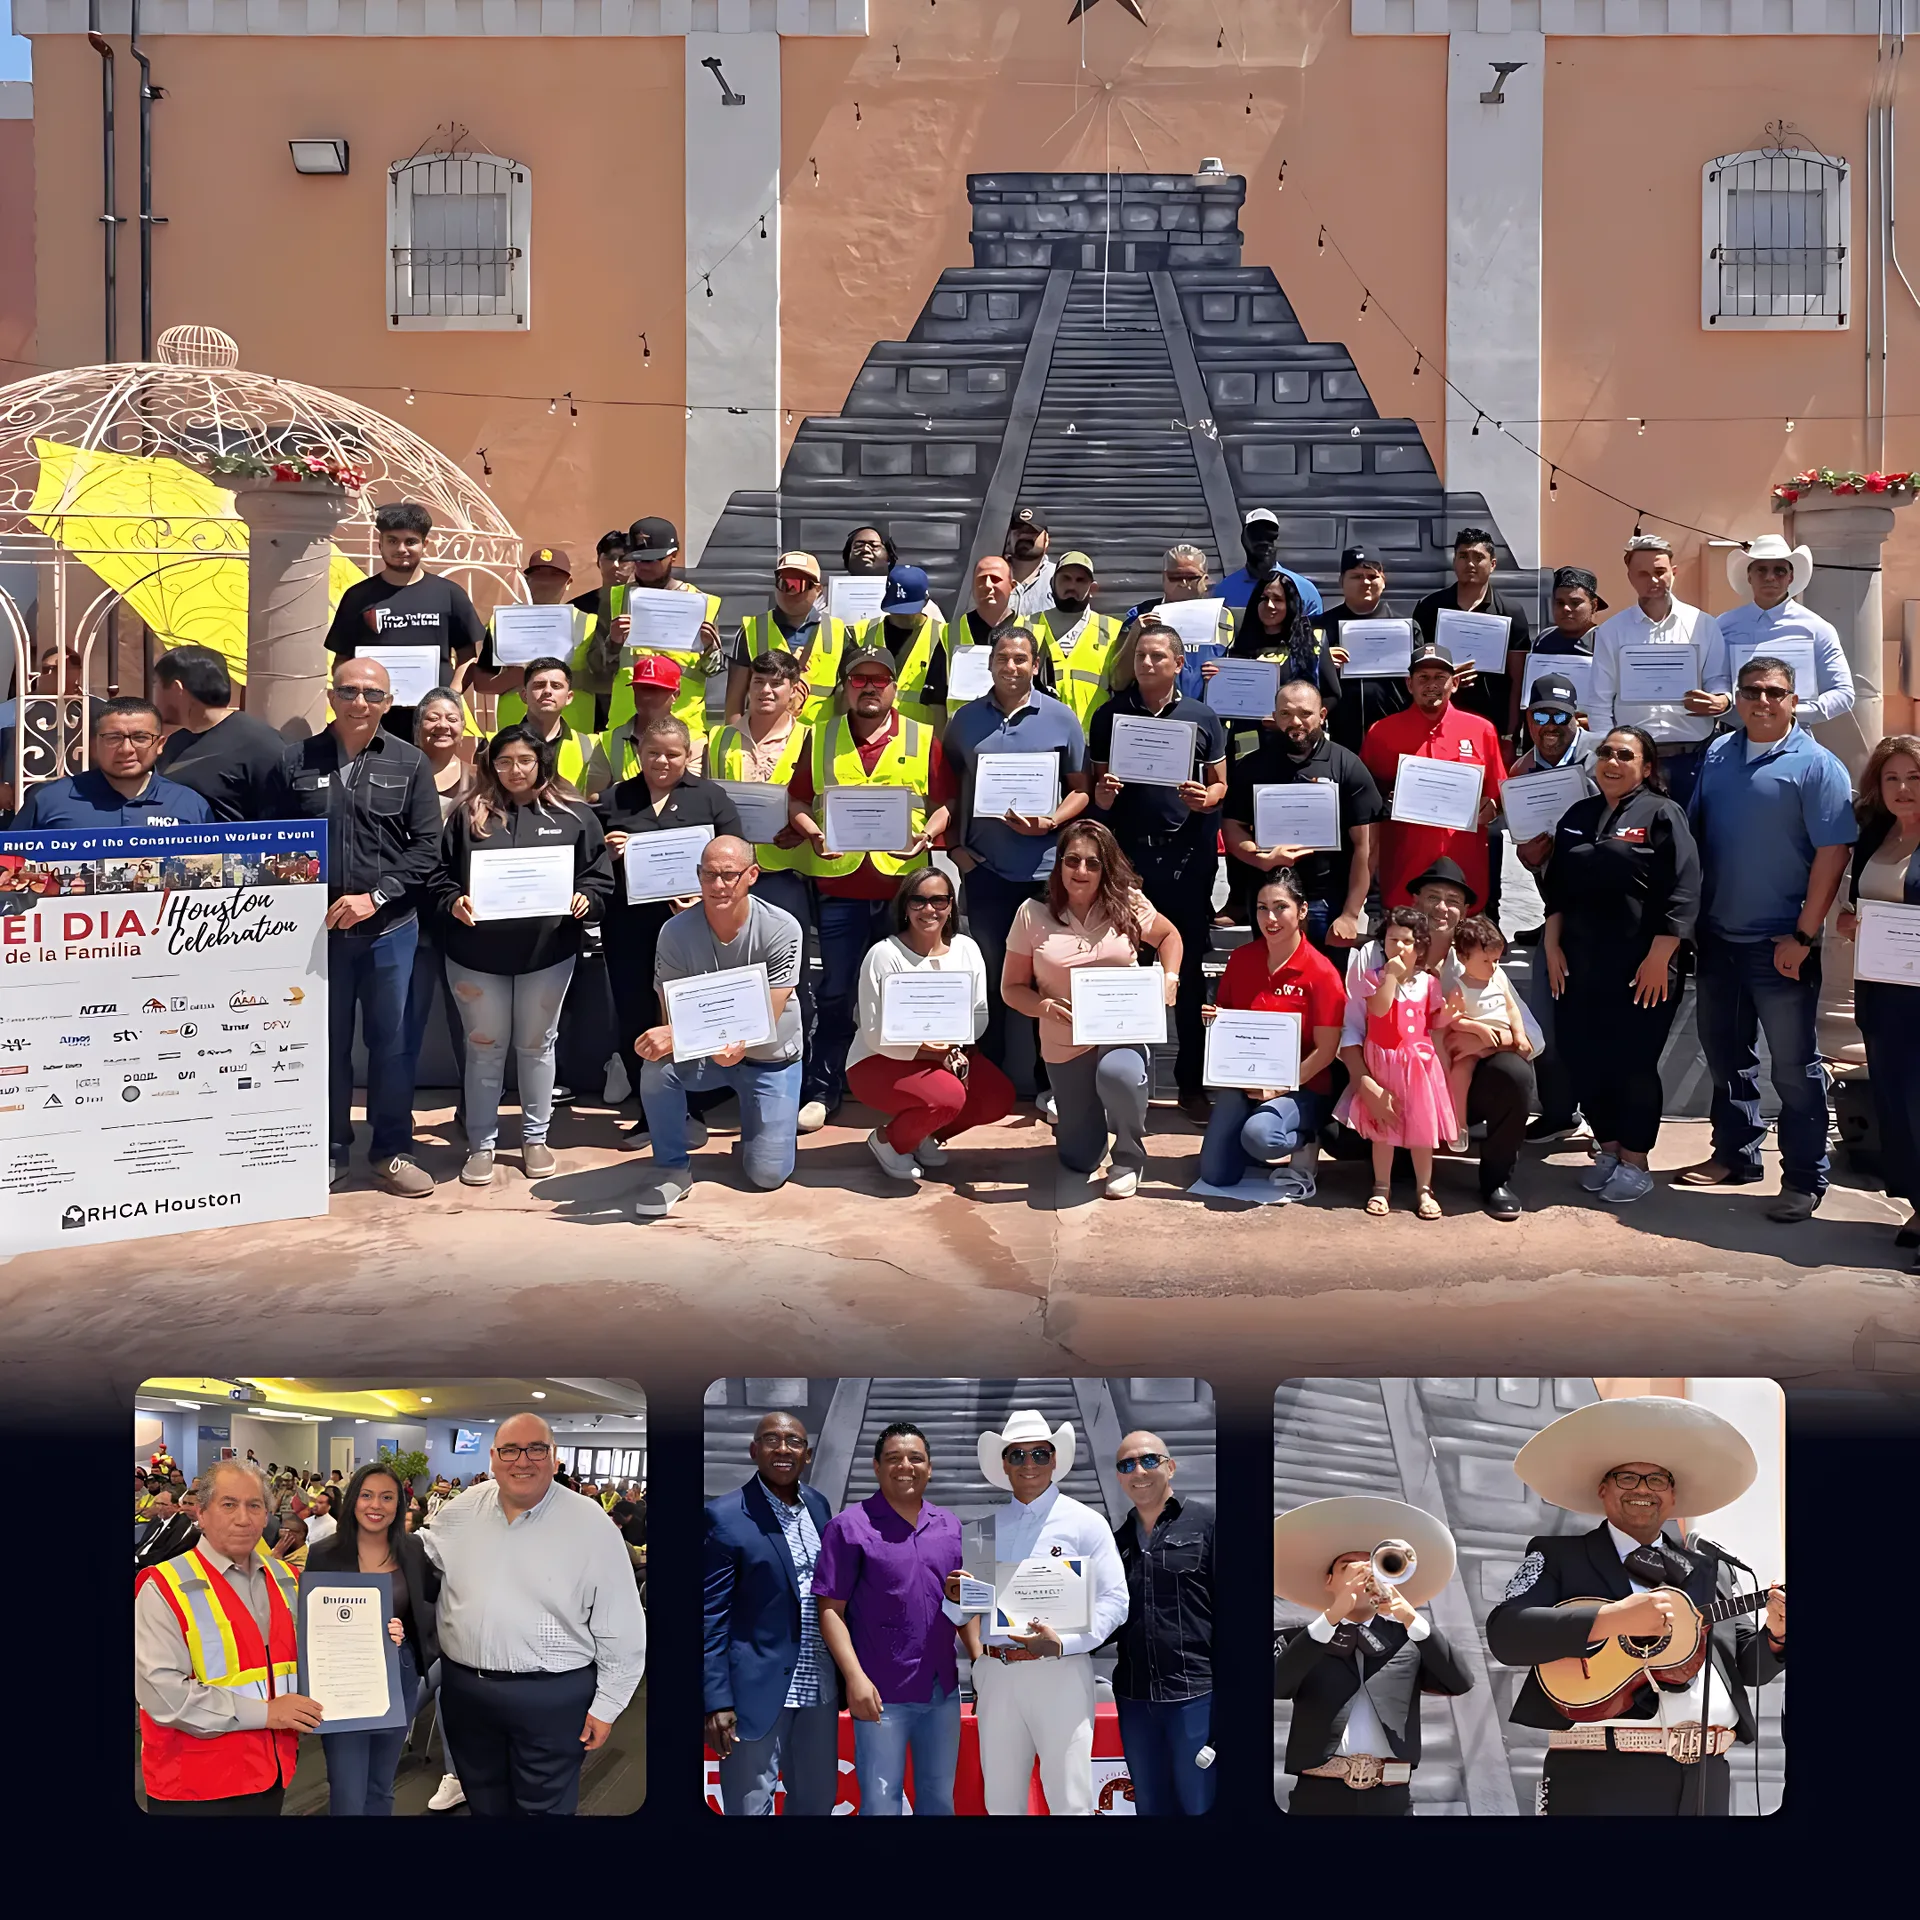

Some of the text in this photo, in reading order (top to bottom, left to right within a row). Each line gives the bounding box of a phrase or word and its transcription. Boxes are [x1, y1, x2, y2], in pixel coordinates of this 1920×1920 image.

[51, 840, 78, 851] Day
[82, 838, 97, 848] of
[102, 838, 124, 847] the
[129, 834, 220, 847] Construction
[225, 832, 272, 842] Worker
[277, 830, 315, 840] Event
[167, 886, 275, 927] Houston
[168, 914, 298, 956] Celebration
[5, 941, 142, 965] de la Familia
[87, 1193, 241, 1222] RHCA Houston
